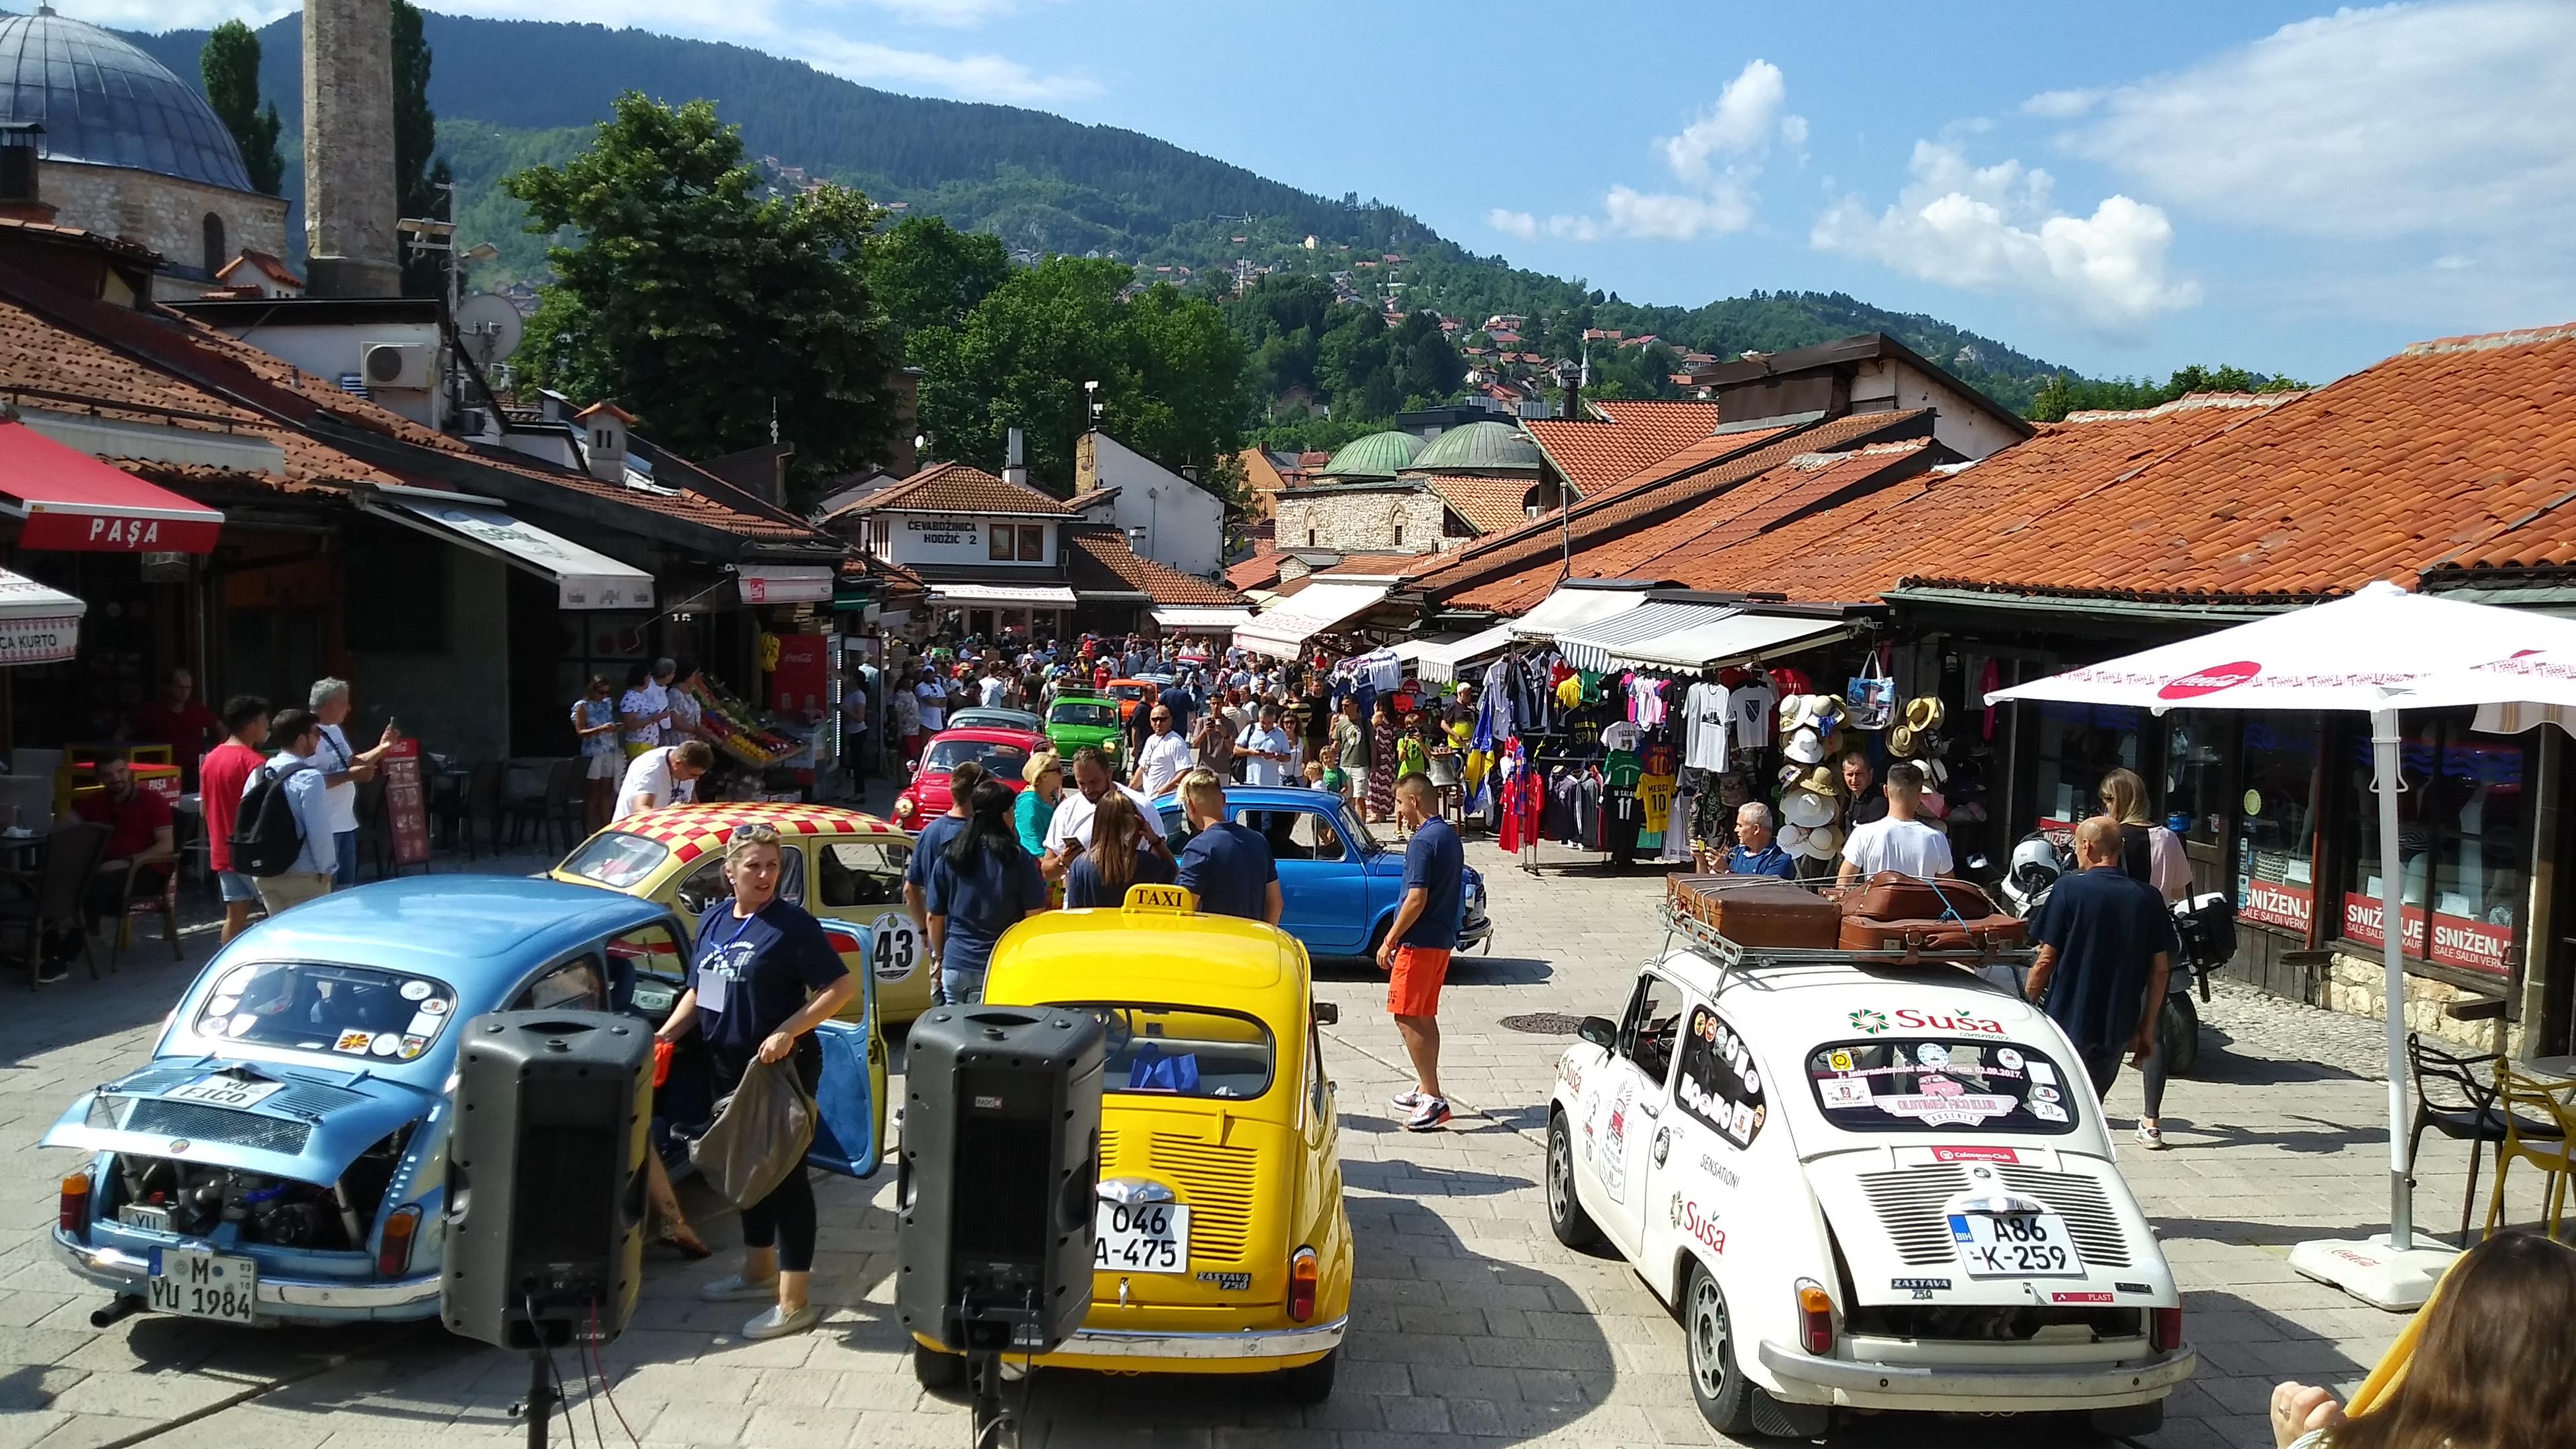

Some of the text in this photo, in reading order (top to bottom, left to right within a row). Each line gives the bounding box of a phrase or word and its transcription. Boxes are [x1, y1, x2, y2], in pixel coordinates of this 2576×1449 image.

[969, 535, 977, 545] 2
[18, 634, 57, 648] KURTO
[1648, 784, 1668, 792] MESSI
[1617, 798, 1632, 820] 11
[1652, 794, 1666, 811] 10
[1135, 889, 1183, 907] TAXI
[2261, 912, 2283, 925] SALDI
[2347, 922, 2365, 934] SALE
[874, 929, 914, 968] 43
[2434, 945, 2455, 958] SALE
[2456, 950, 2479, 963] SALDI
[1895, 1009, 2006, 1034] Suša
[1975, 1067, 2023, 1080] 02.09.2017.
[1971, 1100, 1997, 1110] KLUB
[1932, 1113, 1974, 1122] AUSTRIA
[1701, 1154, 1740, 1190] SENSATION!
[1684, 1201, 1726, 1255] Suša
[1993, 1218, 2047, 1242] A86
[1955, 1232, 1972, 1240] BIH
[192, 1257, 209, 1284] M
[1197, 1272, 1249, 1281] ZASTAVA
[1222, 1281, 1248, 1289] 750
[1893, 1279, 1948, 1287] ZASTAVA
[152, 1276, 251, 1319] YU 1984
[2088, 1293, 2111, 1301] PLAST
